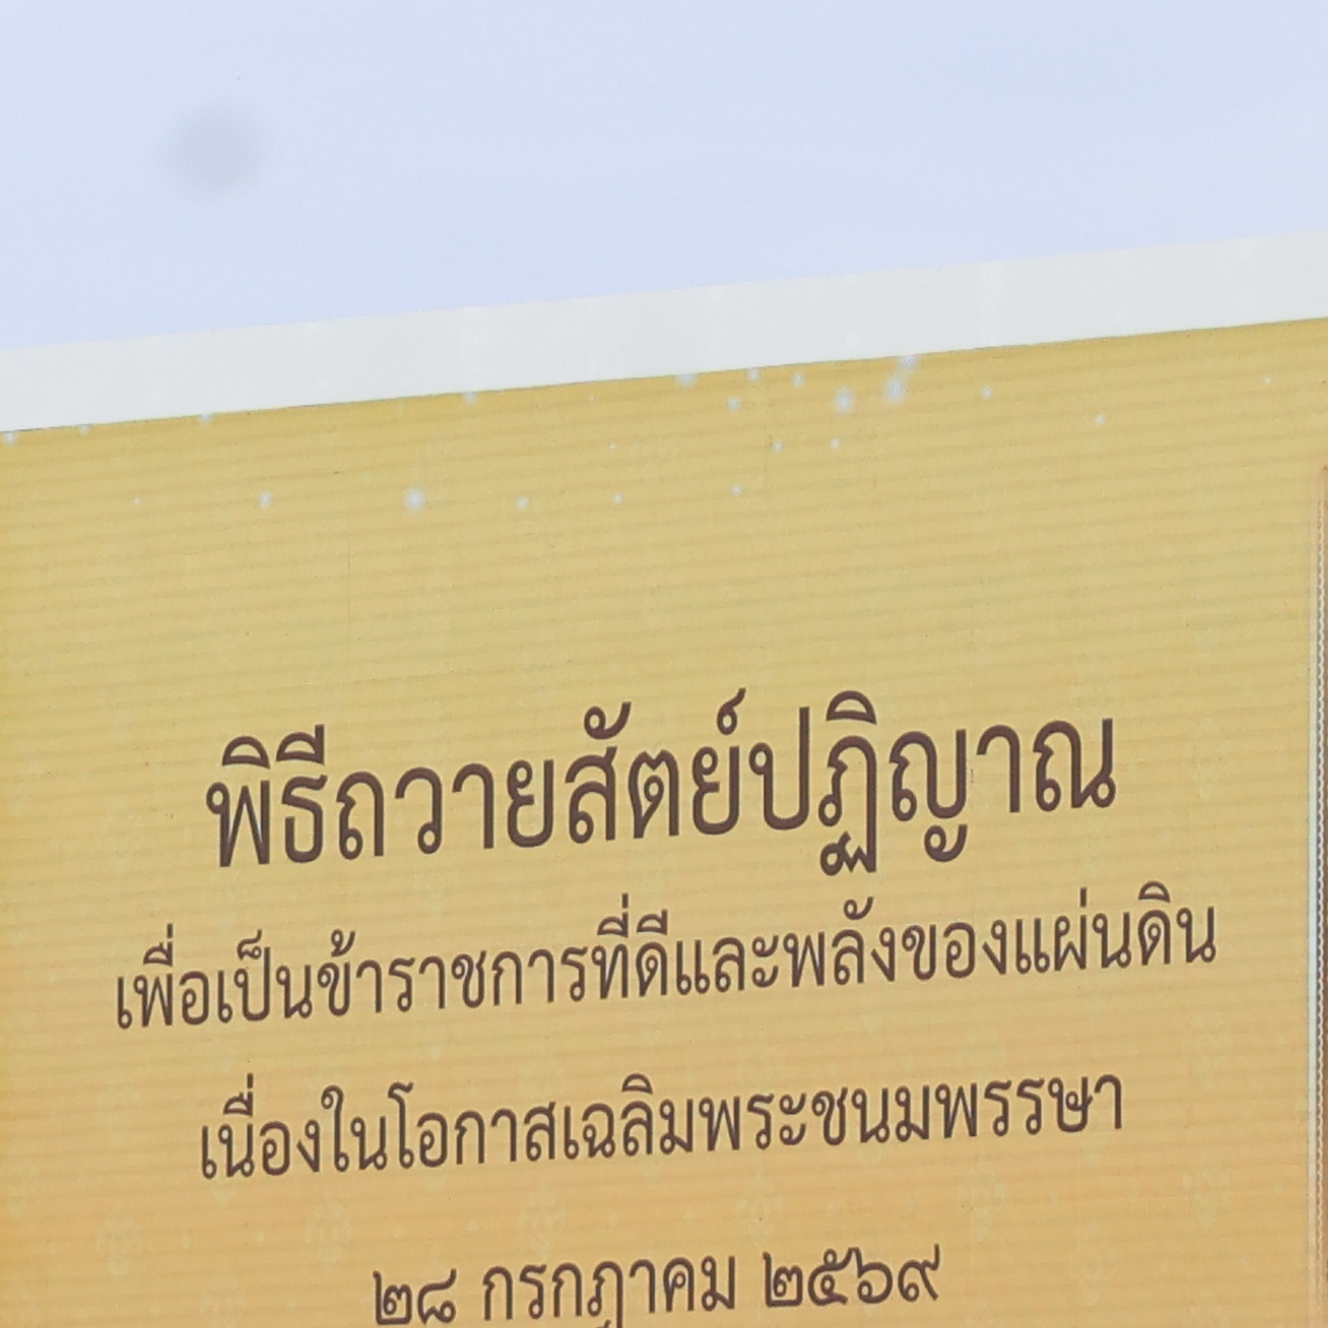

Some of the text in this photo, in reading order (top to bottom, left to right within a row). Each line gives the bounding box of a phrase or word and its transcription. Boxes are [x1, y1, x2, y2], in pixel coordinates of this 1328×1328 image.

[205, 687, 1117, 878] พิธีถวายสัตย์ปฏิญาณ
[116, 880, 1217, 1031] เพื่อเป็นข้าราชการที่ดีและพลังของแผ่นดิน
[200, 1072, 1123, 1181] เนื่องในโอกาสเฉลิมพระชนมพรรษา
[372, 1268, 458, 1327] ๒๘
[762, 1242, 941, 1309] ๒๕๖๙
